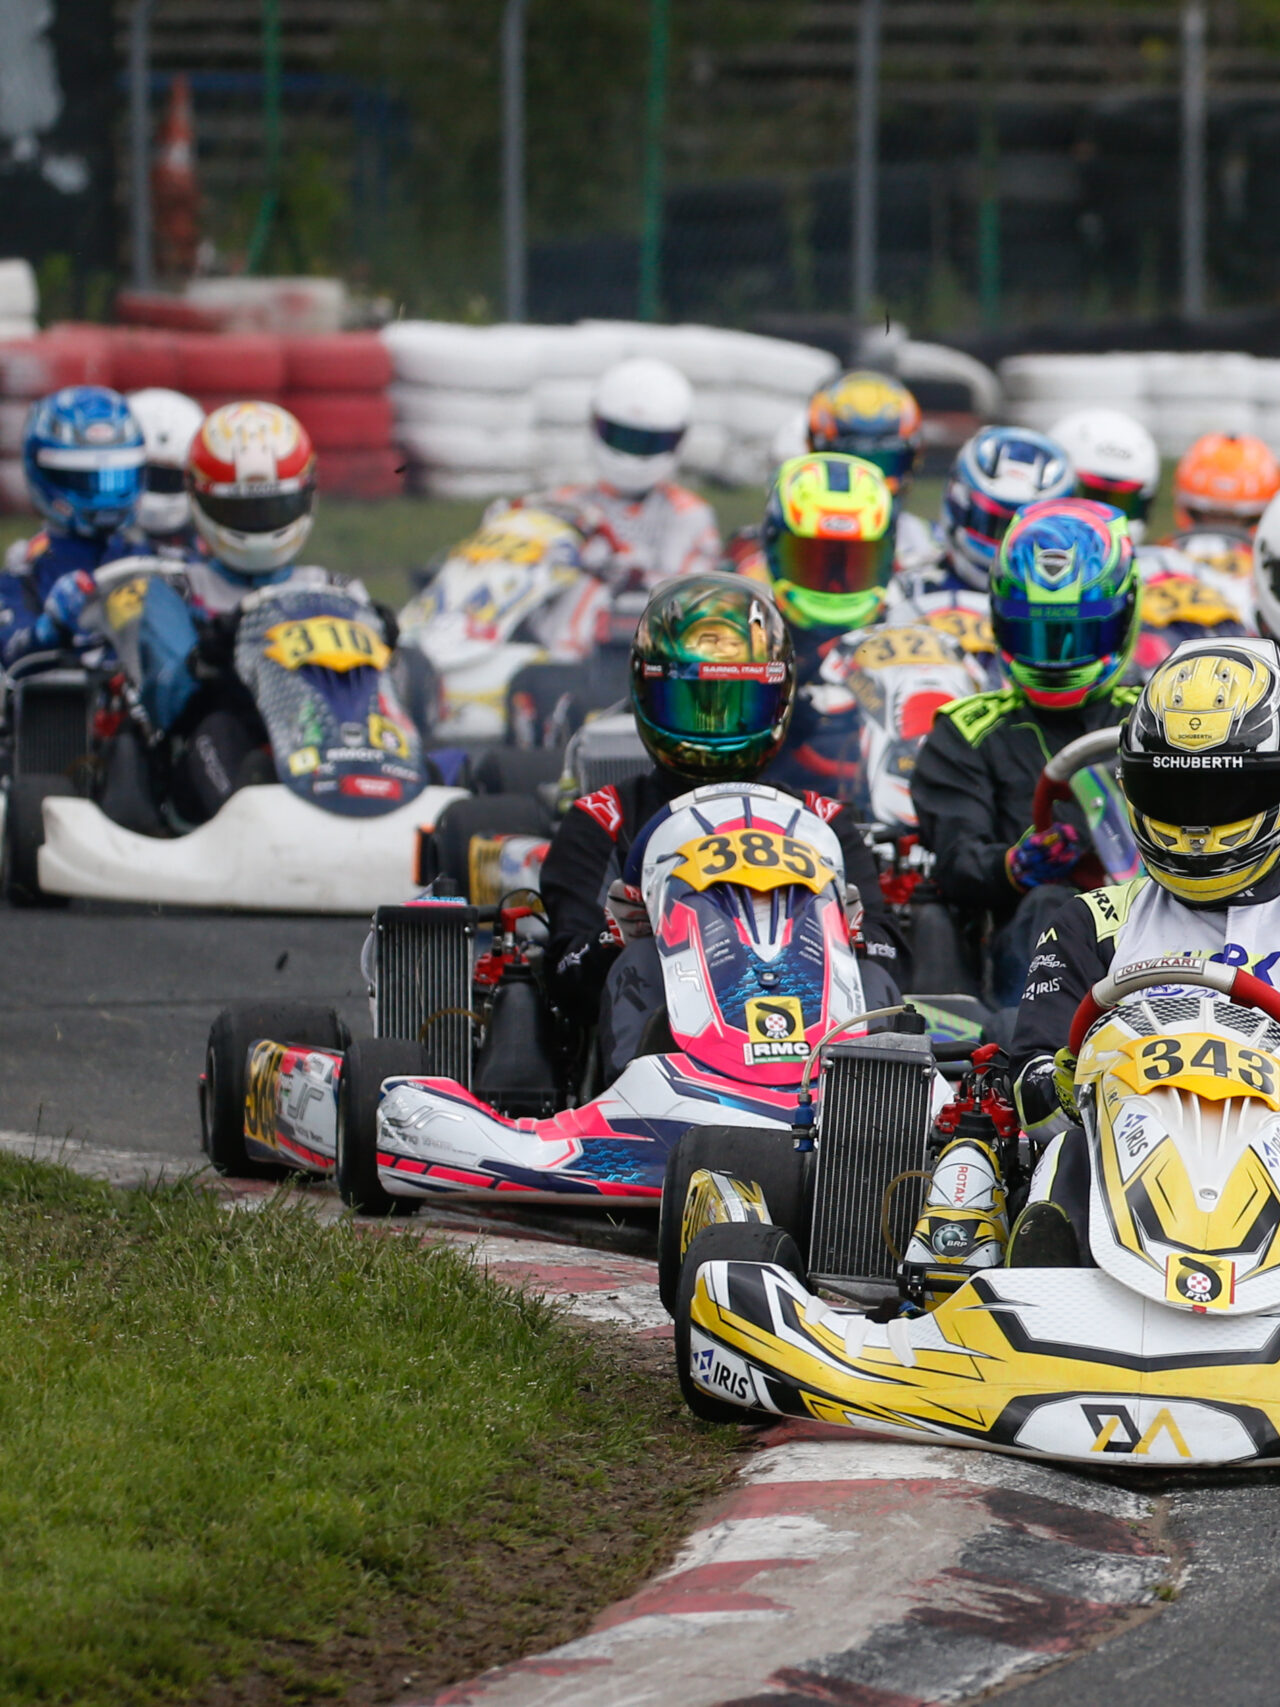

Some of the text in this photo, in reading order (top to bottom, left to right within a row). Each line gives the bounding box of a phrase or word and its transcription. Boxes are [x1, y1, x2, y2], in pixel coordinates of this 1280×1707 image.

[1178, 733, 1213, 741] SCHUBERTH
[1153, 756, 1244, 769] SCHUBERTH
[697, 832, 816, 879] 385
[1036, 978, 1061, 995] IRIS
[753, 1043, 810, 1056] RMC
[1142, 1039, 1275, 1095] 343
[1124, 1124, 1149, 1158] IRIS
[953, 1165, 968, 1203] ROTAX
[946, 1239, 968, 1247] BRP
[1185, 1288, 1213, 1304] PZM
[712, 1360, 750, 1399] IRIS
